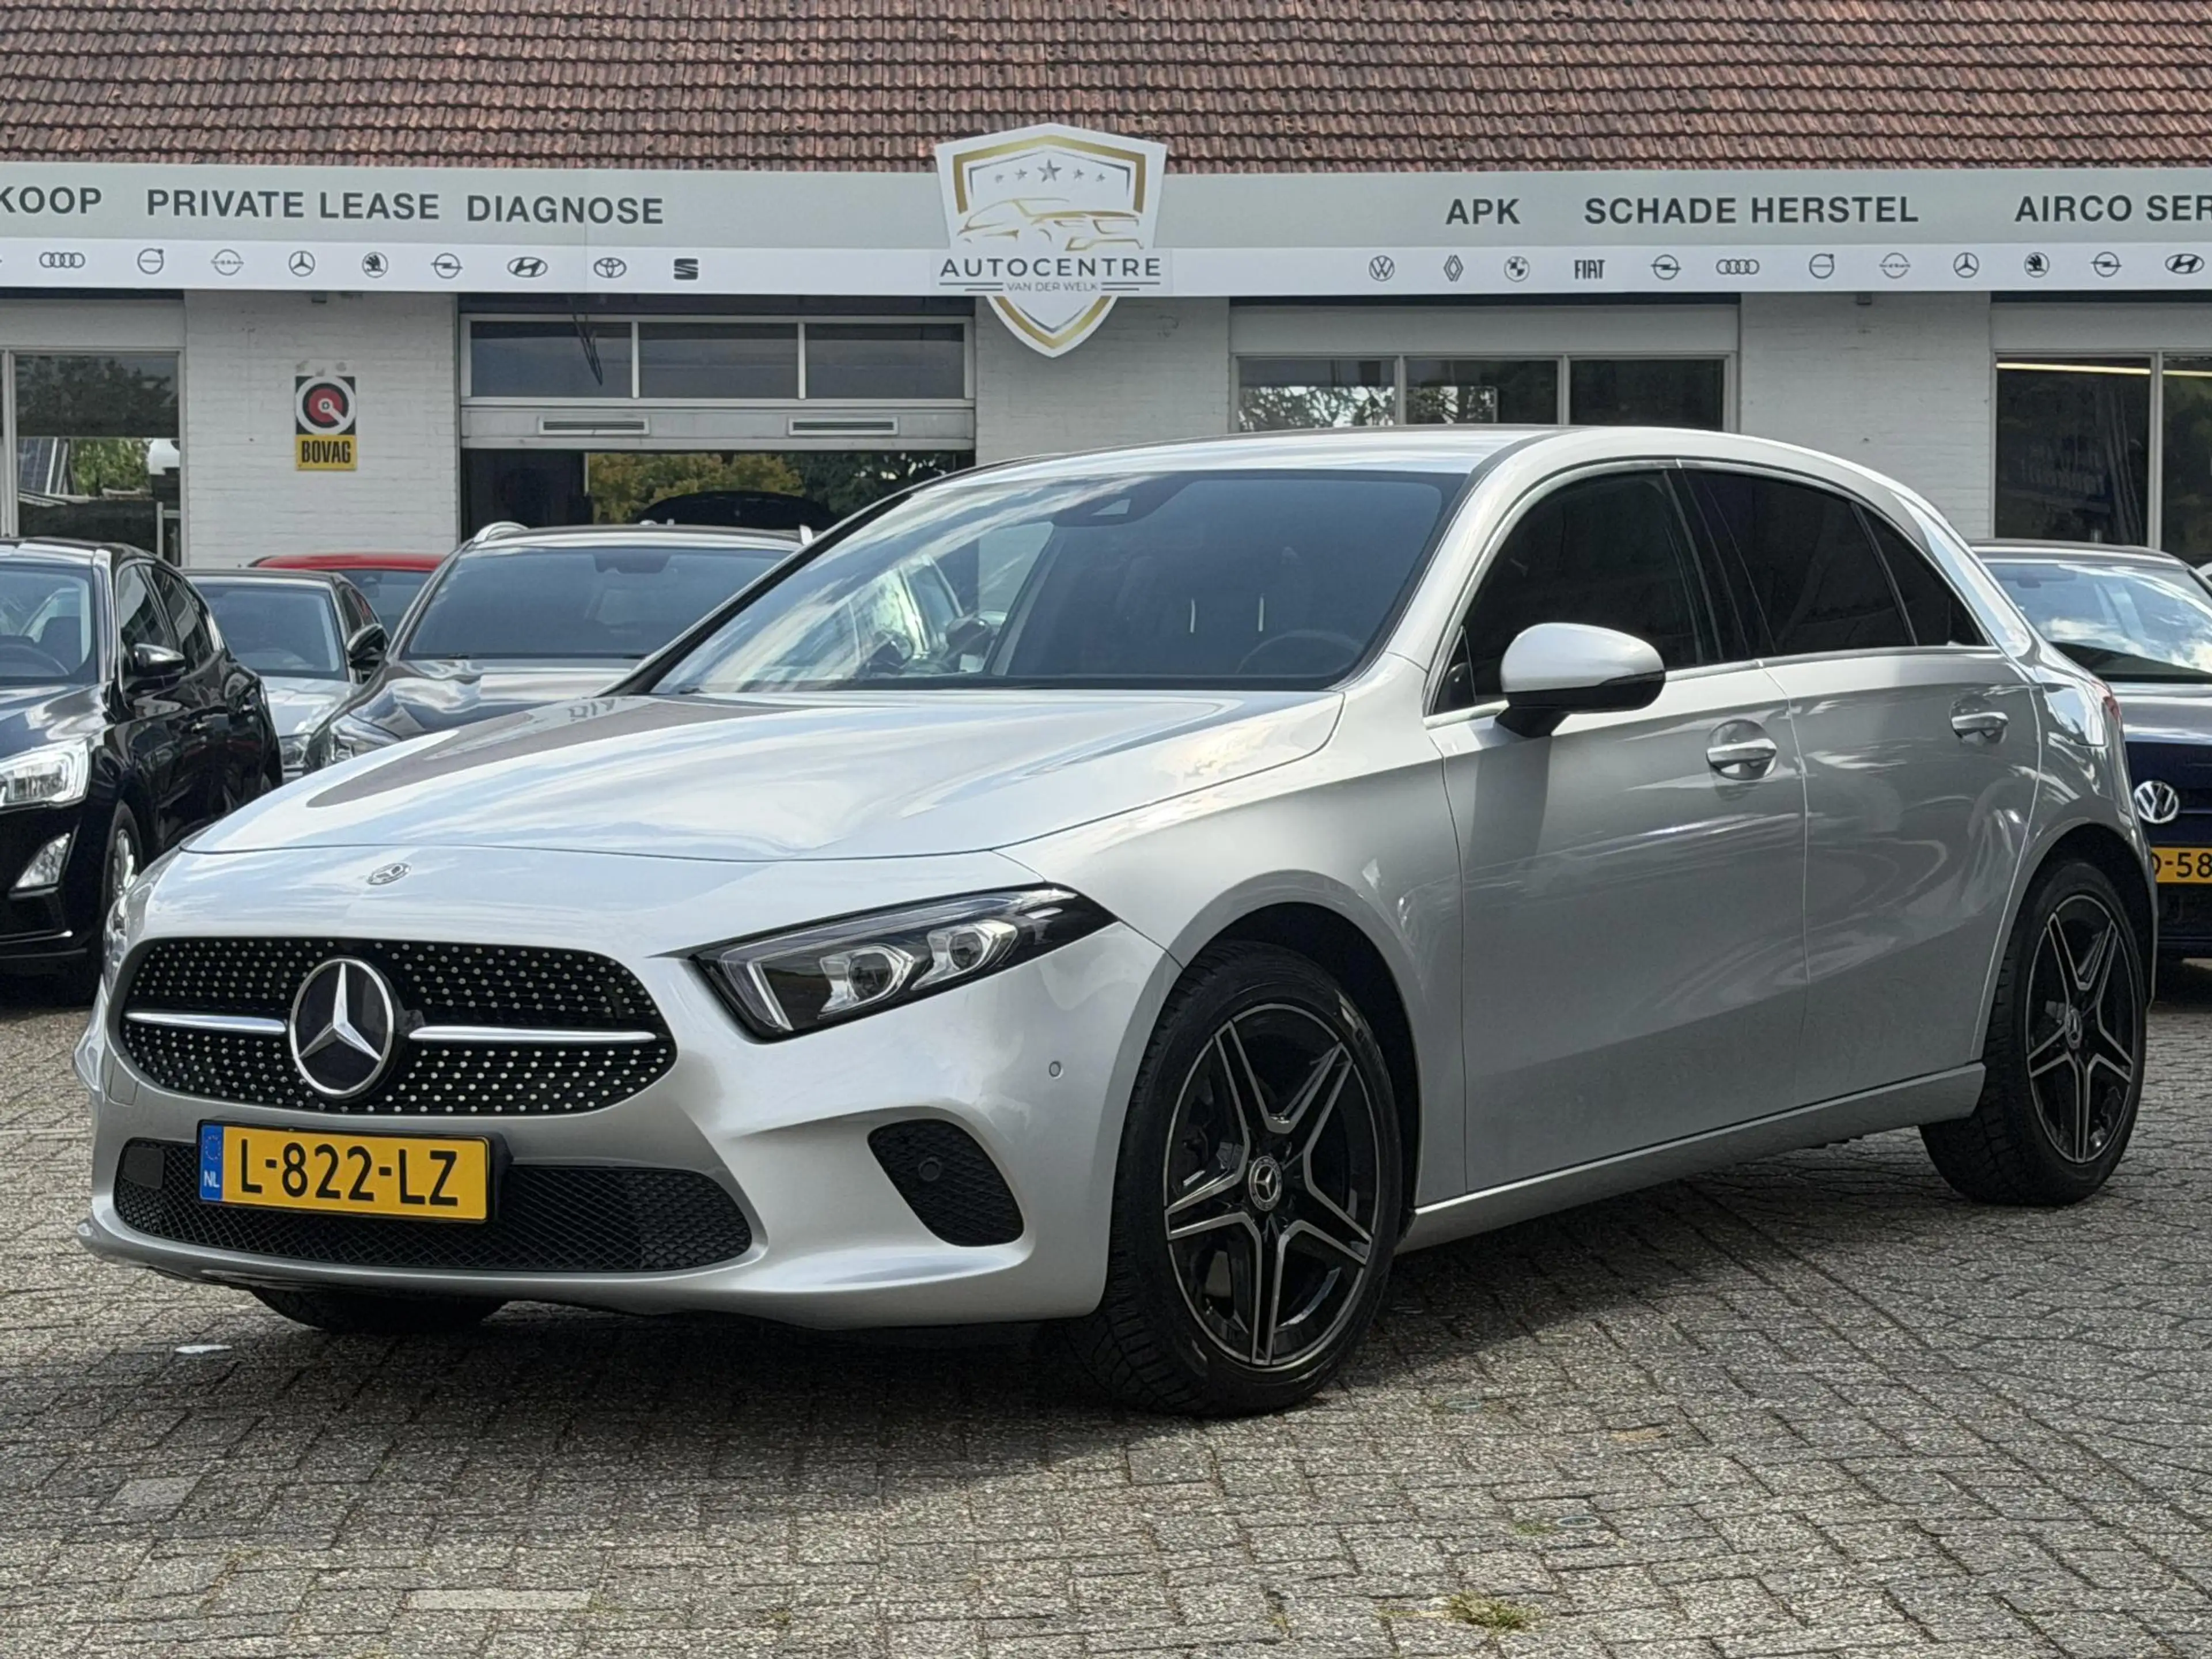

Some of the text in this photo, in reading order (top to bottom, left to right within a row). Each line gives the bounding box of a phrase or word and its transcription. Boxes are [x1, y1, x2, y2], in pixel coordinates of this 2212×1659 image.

[0, 186, 102, 214] KOOP
[147, 189, 440, 220] PRIVATE LEASE
[467, 195, 663, 224] DIAGNOSE
[1445, 198, 1521, 225] APK
[1584, 196, 1919, 225] SCHADE HERSTEL
[2014, 195, 2212, 222] AIRCO SER
[940, 257, 1161, 277] AUTOCENTRE
[1574, 259, 1605, 279] FIAT
[1006, 282, 1031, 292] VAN
[1035, 282, 1061, 292] DER
[301, 440, 351, 464] BOVAG
[203, 1170, 220, 1188] NL
[241, 1138, 459, 1206] L-822-LZ
